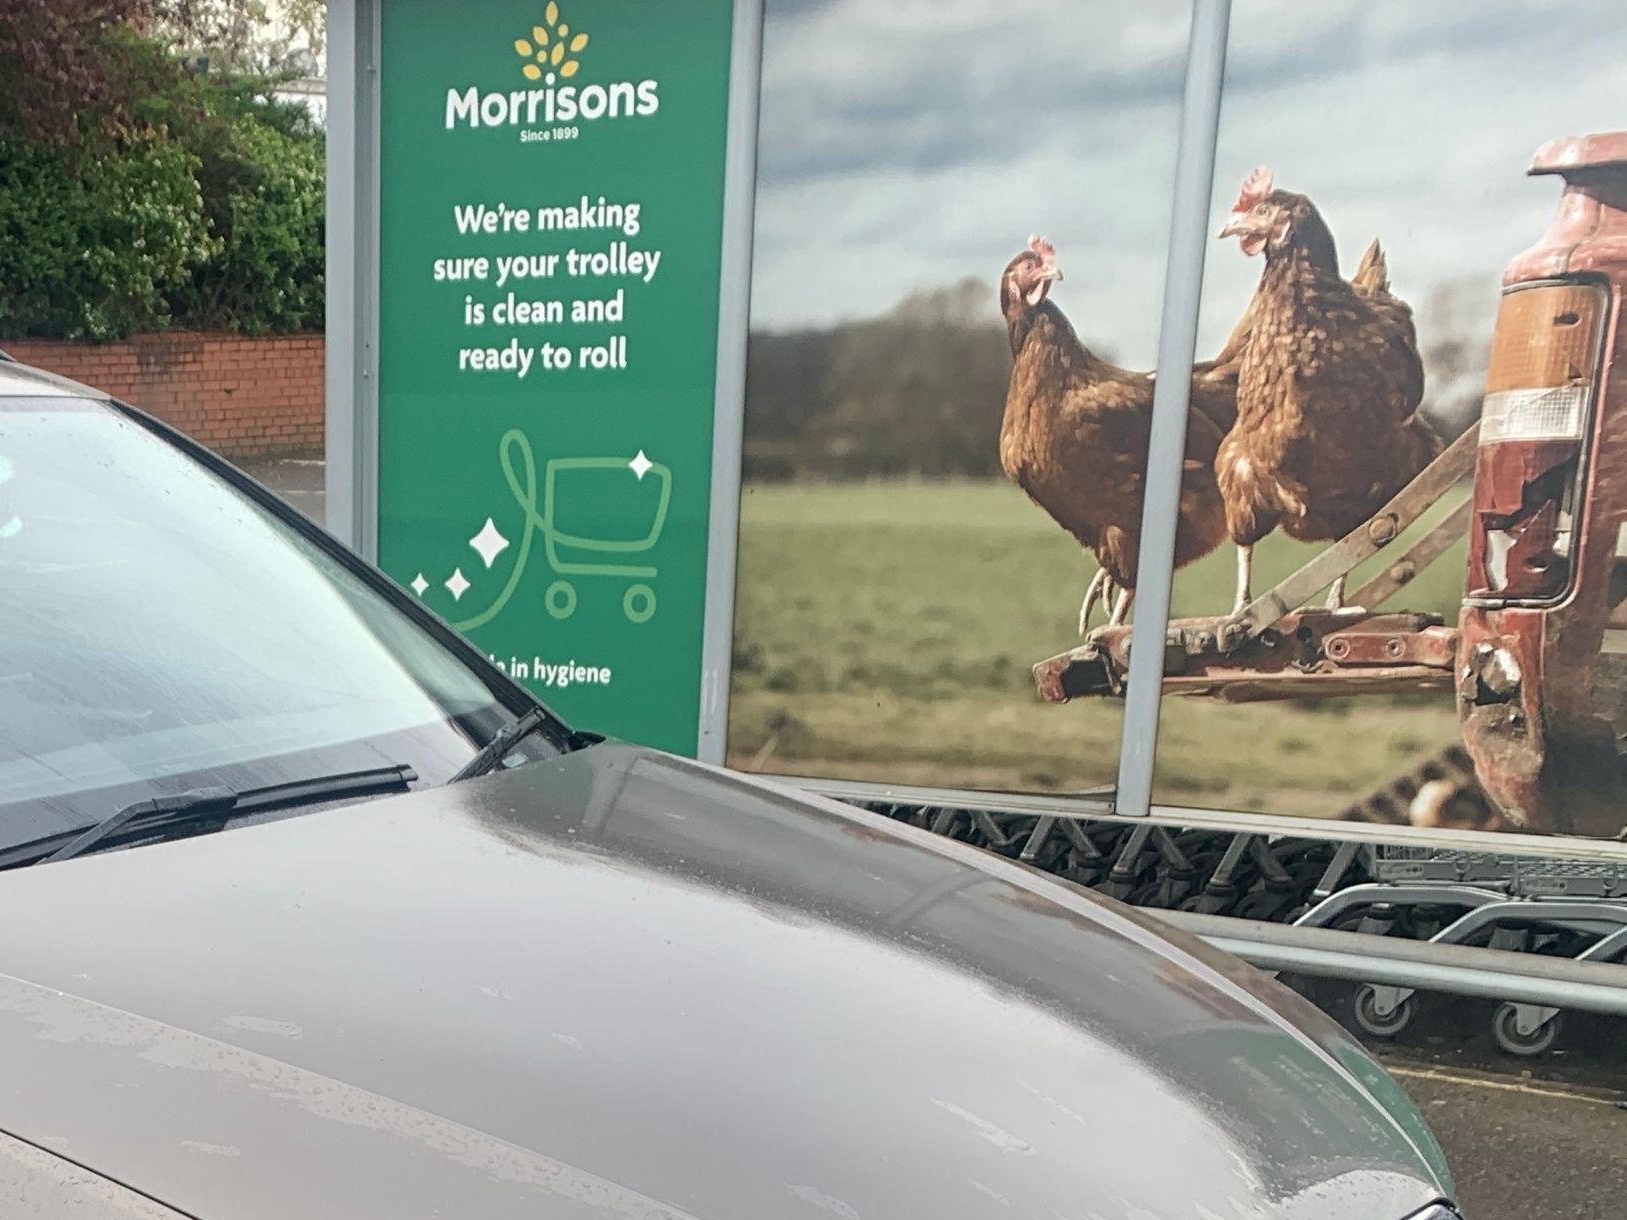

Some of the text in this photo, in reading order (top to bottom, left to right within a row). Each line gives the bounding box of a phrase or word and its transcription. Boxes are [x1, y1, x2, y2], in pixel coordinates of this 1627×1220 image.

[445, 72, 659, 130] Morrisons
[520, 126, 579, 142] Since 1899
[454, 196, 641, 236] We're making
[433, 242, 662, 287] sure your trolley
[465, 289, 624, 325] is clean and
[459, 336, 627, 378] ready to roll
[511, 656, 529, 678] in
[533, 656, 611, 687] hygiene
